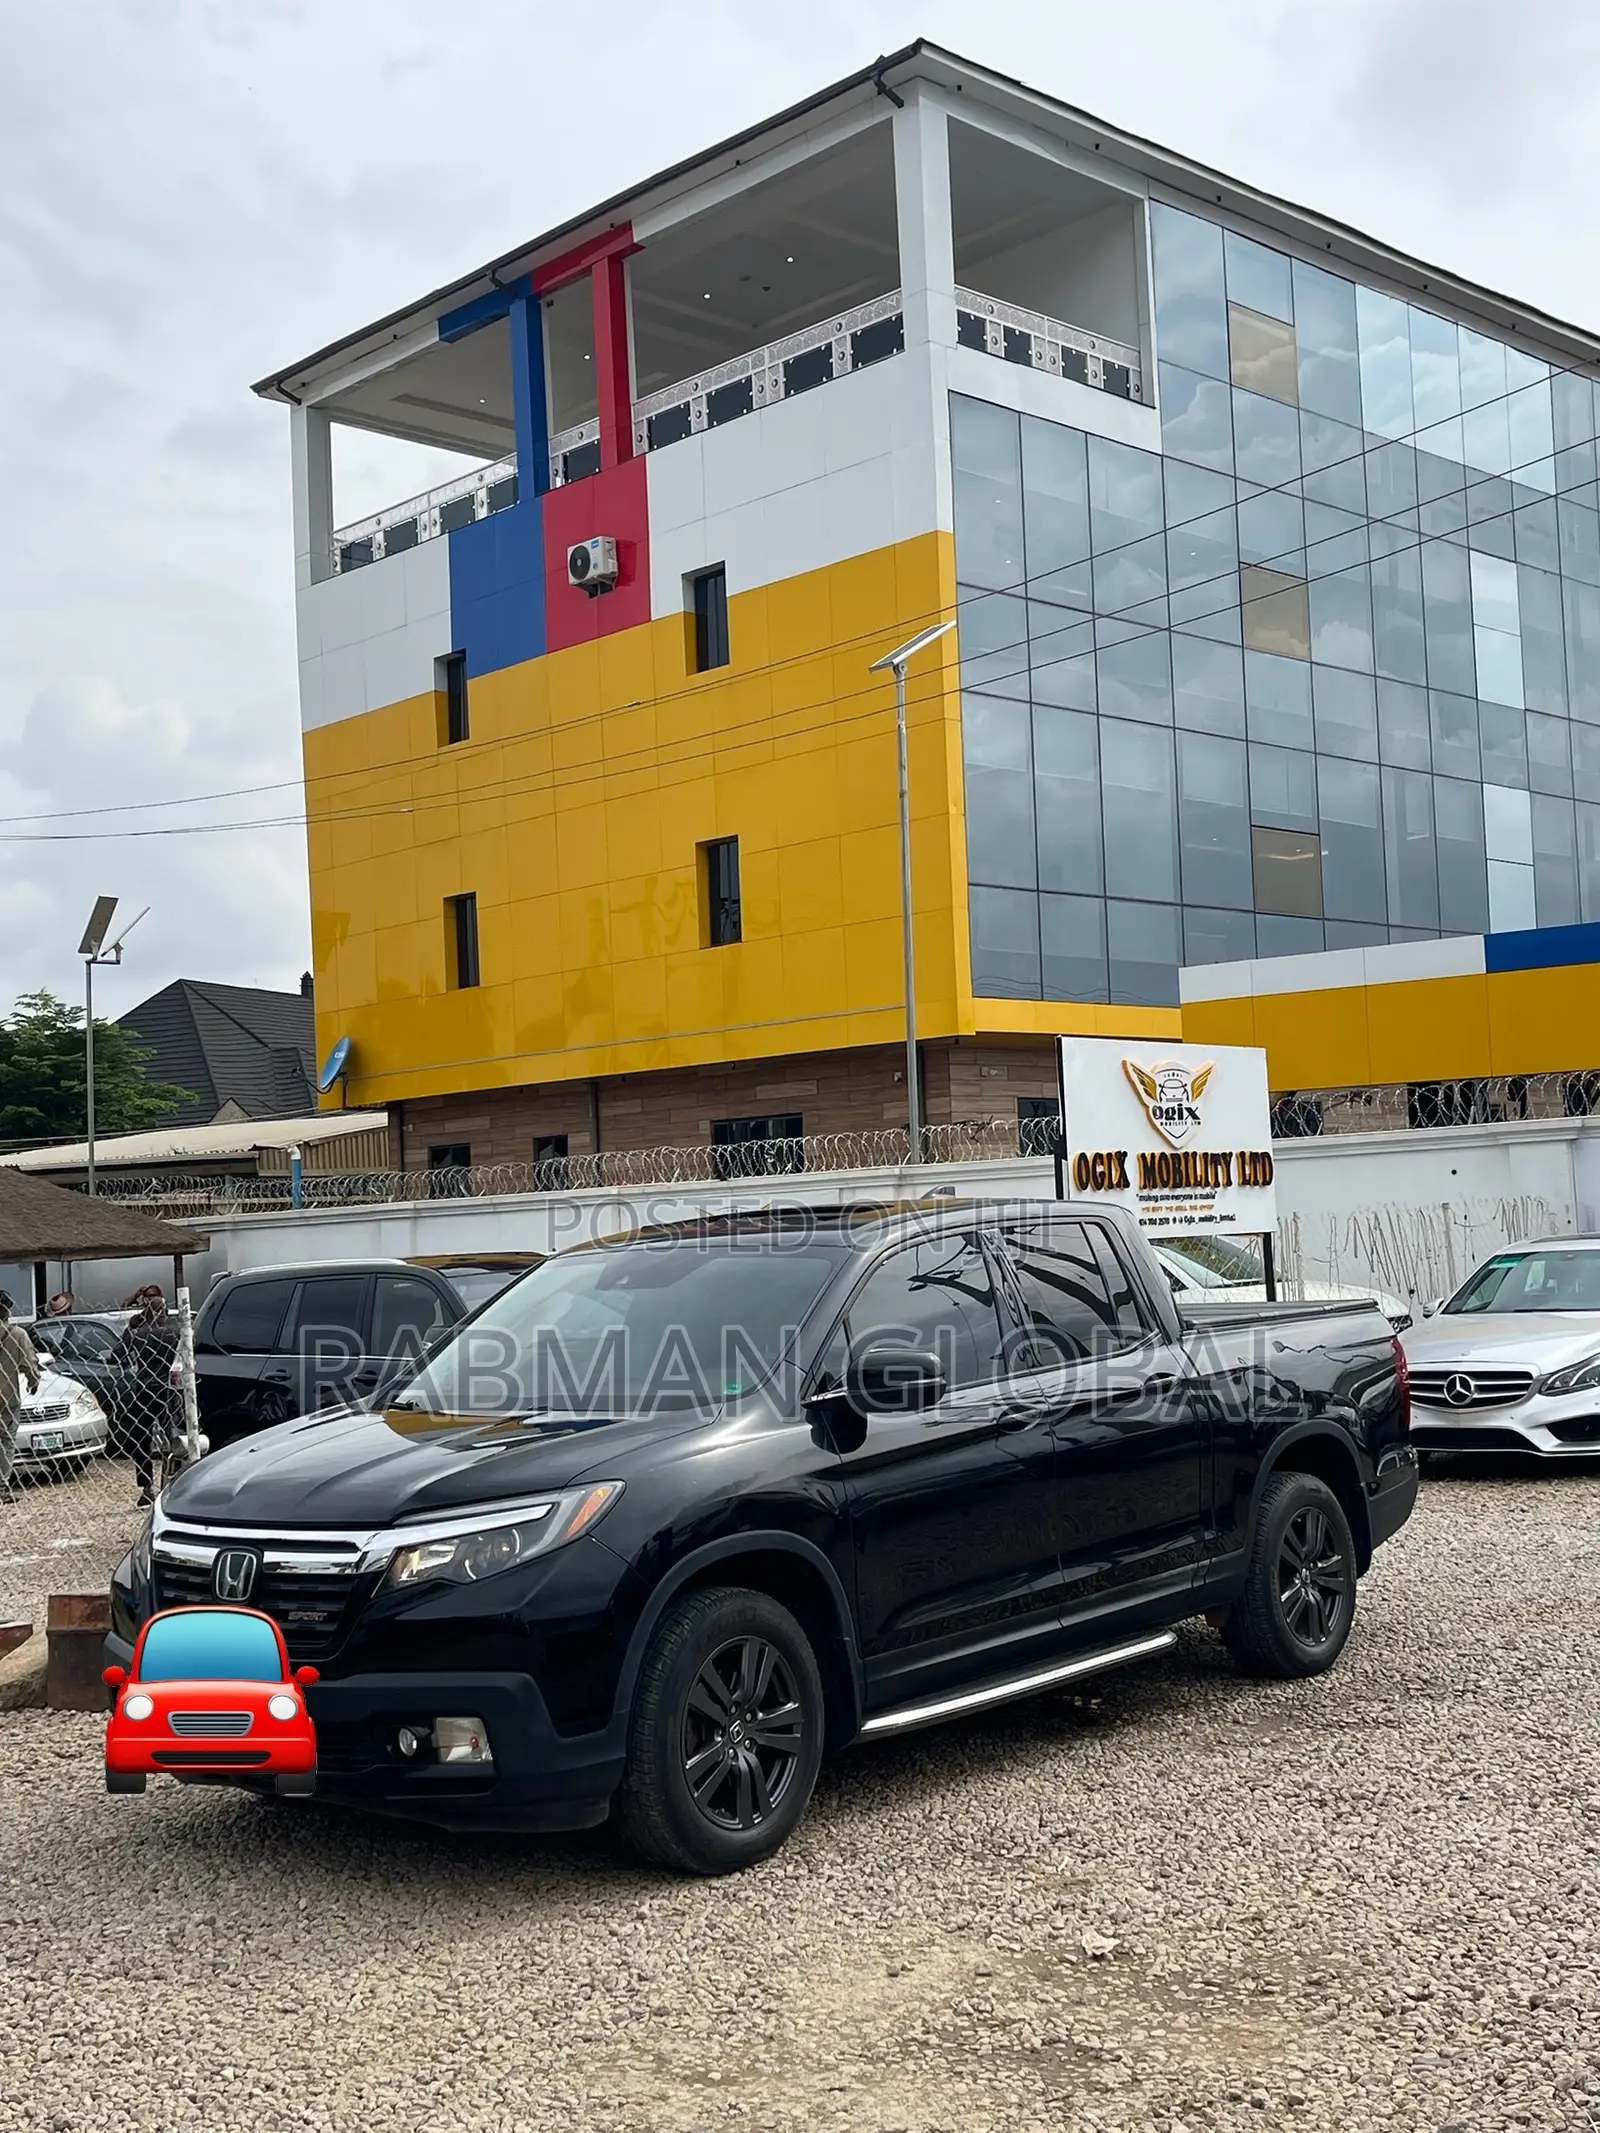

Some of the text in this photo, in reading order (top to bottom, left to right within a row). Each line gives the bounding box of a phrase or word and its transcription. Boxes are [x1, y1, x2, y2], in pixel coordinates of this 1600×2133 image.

[1073, 1150, 1274, 1191] OGIX MOBILITY LTD
[288, 1611, 328, 1621] SPORT
